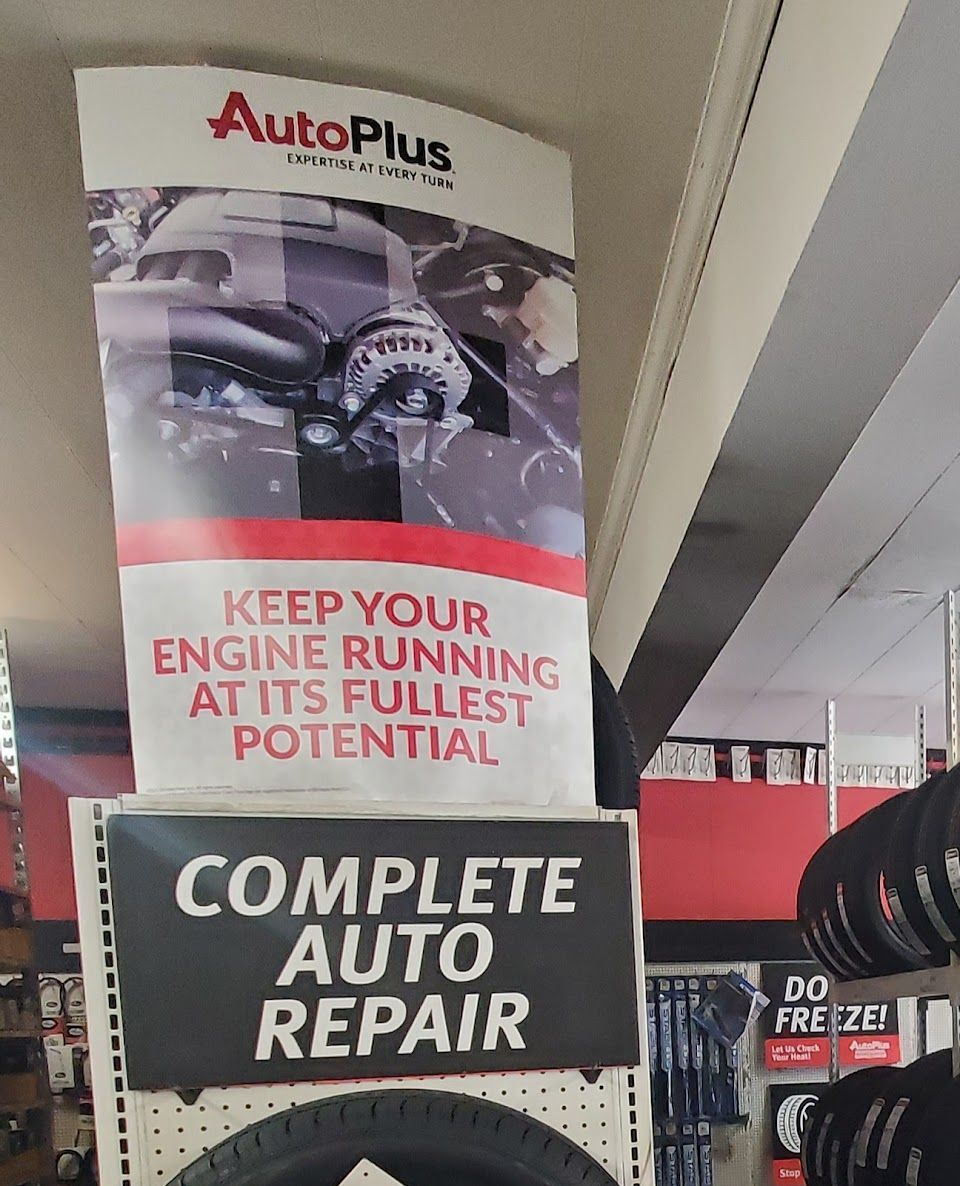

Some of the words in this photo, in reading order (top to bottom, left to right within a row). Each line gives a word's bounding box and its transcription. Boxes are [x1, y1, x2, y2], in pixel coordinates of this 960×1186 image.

[207, 91, 454, 175] AutoPlus
[287, 152, 355, 171] EXPERTISE
[359, 163, 374, 173] AT
[378, 165, 417, 181] EVERY
[421, 173, 454, 191] TURN
[223, 590, 344, 626] KEEP
[352, 591, 491, 638] YOUR
[153, 635, 328, 675] ENGINE
[343, 635, 560, 691] RUNNING
[189, 681, 239, 718] AT
[259, 679, 327, 716] ITS
[343, 679, 533, 728] FULLEST
[233, 723, 499, 766] POTENTIAL
[175, 854, 582, 917] COMPLETE
[276, 922, 494, 986] AUTO
[255, 992, 530, 1060] REPAIR
[771, 1044, 784, 1053] Let
[779, 1168, 801, 1179] Stop
